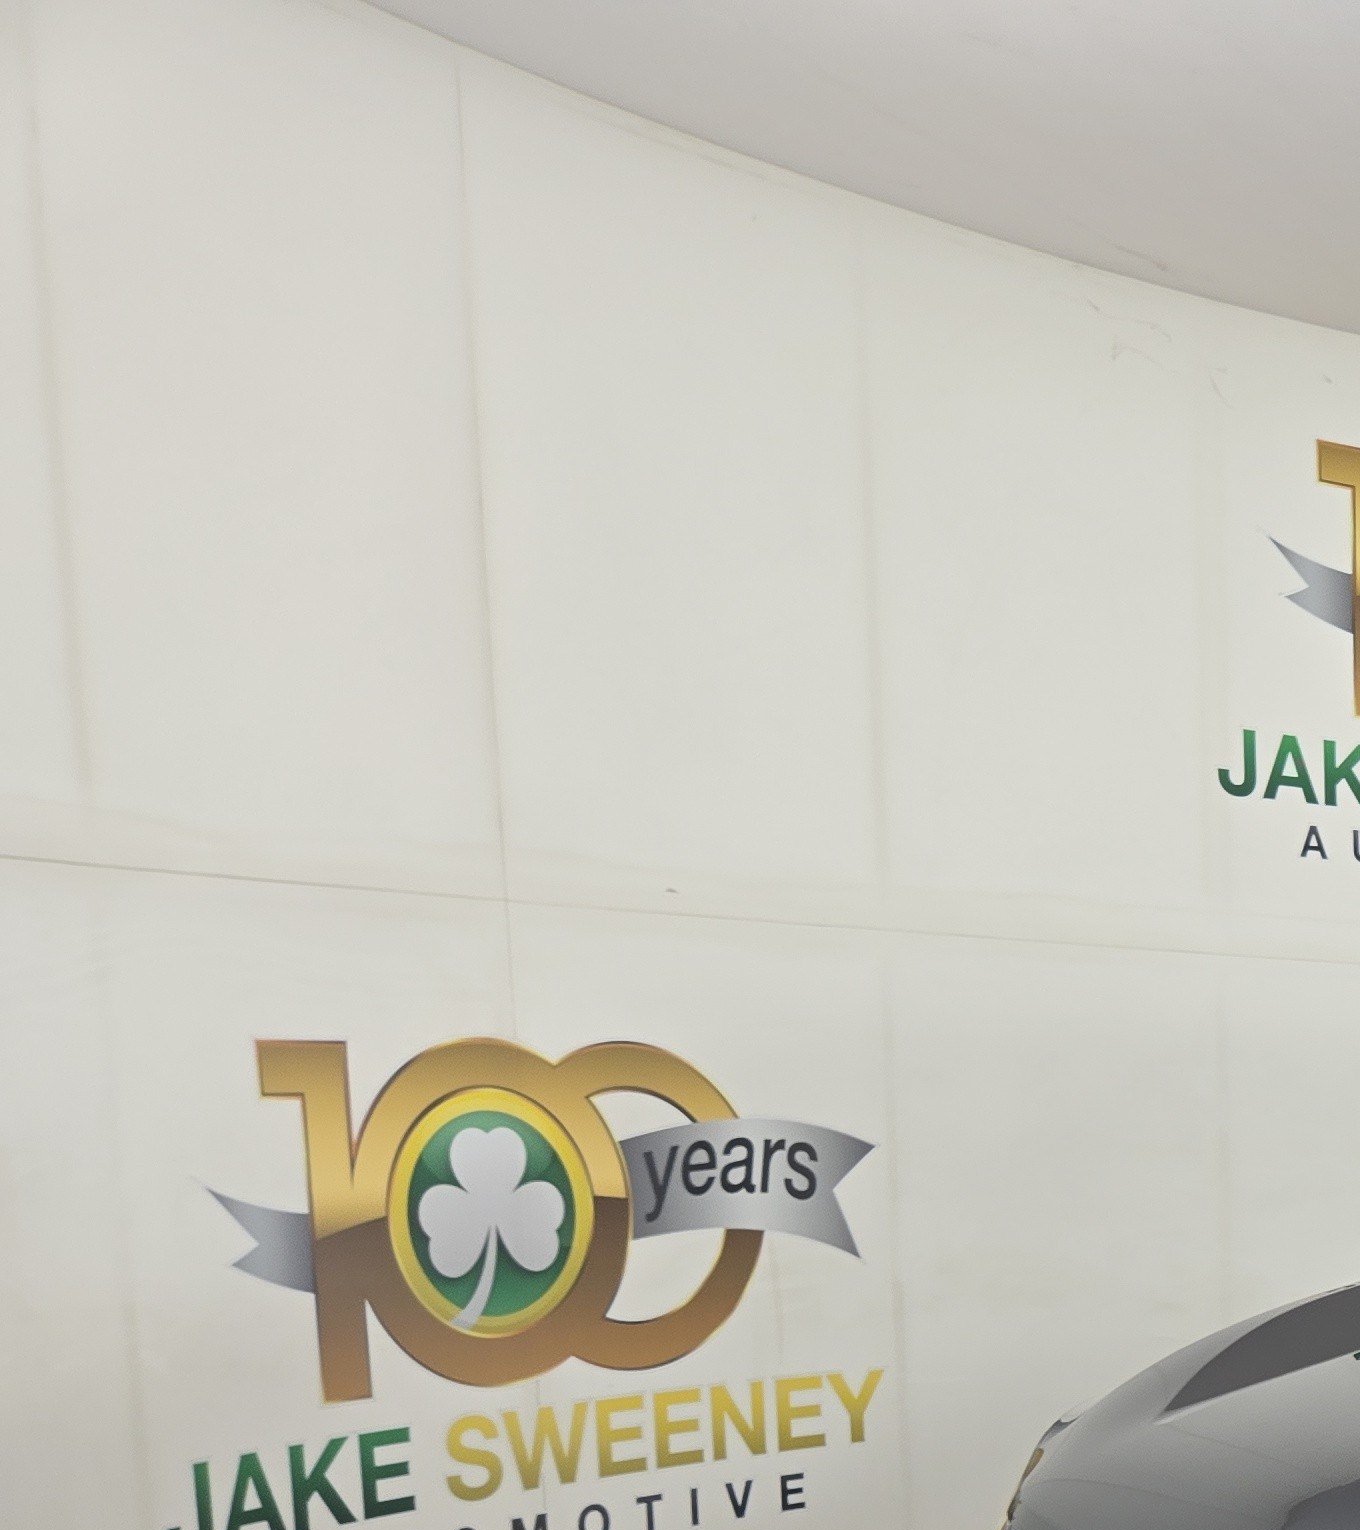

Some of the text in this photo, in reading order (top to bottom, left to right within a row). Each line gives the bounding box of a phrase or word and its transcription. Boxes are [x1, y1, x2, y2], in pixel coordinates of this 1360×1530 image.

[255, 1036, 819, 1404] 100 years
[443, 1368, 885, 1502] SWEENEY
